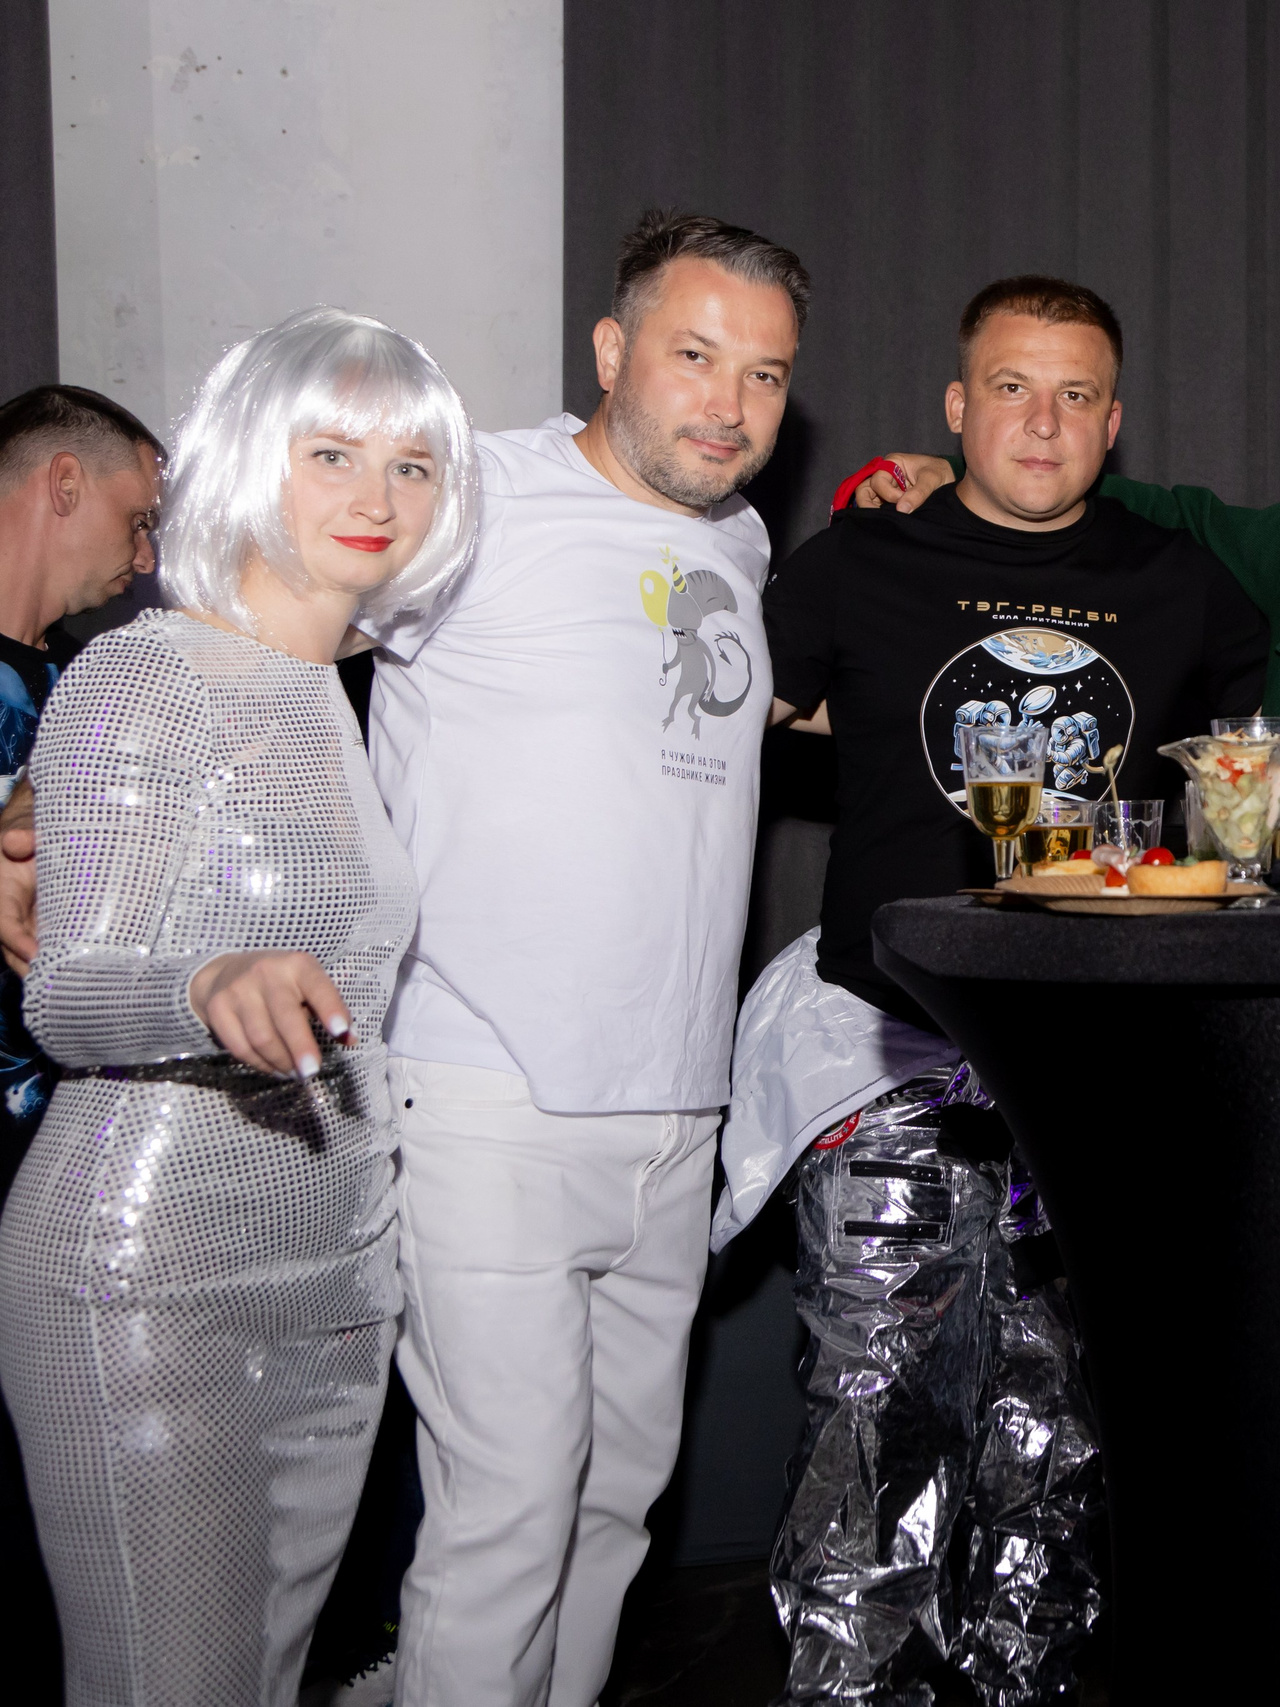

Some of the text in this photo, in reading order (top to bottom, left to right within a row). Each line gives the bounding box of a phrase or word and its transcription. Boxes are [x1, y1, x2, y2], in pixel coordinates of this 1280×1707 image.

[957, 601, 1118, 623] ТЭГ-РЕГБИ
[1025, 616, 1090, 628] ПРИТЯЖЕНИЯ
[661, 749, 727, 771] Я ЧУЖОЙ НА ЭТОМ
[661, 765, 727, 786] ПРАЗДНИКЕ ЖИЗНИ
